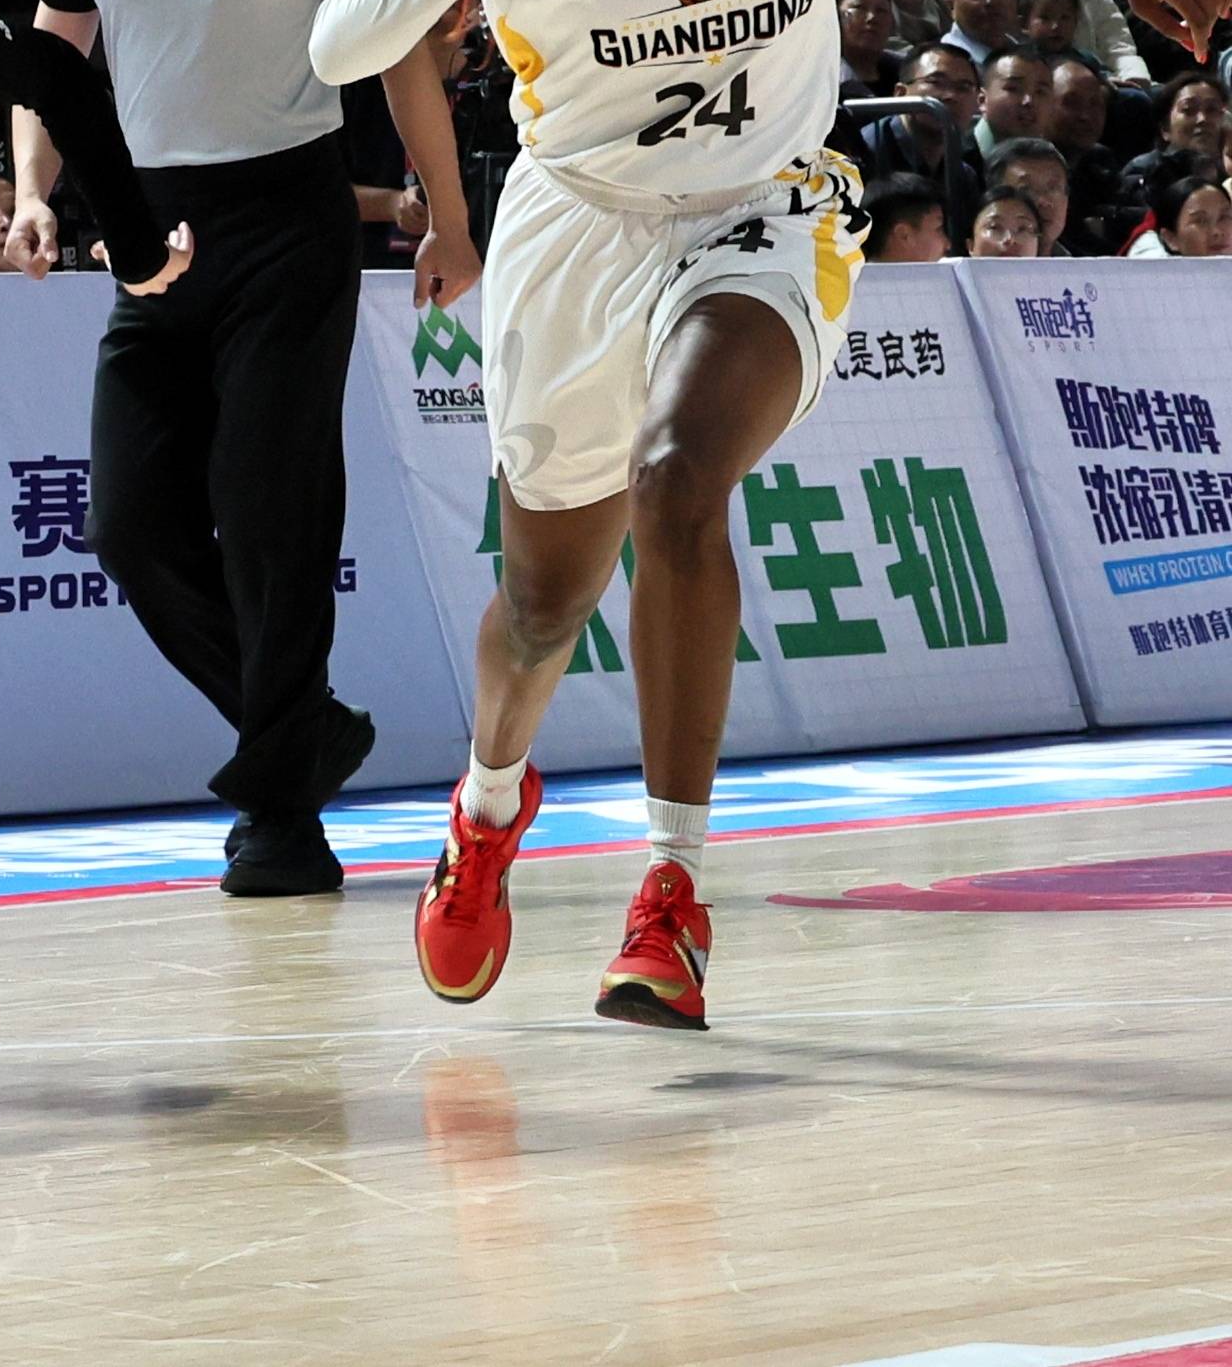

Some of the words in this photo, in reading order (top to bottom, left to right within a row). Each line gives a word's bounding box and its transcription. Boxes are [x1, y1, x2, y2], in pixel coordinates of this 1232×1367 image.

[636, 69, 756, 147] 24
[1056, 378, 1221, 455] 斯跑特牌
[1111, 563, 1158, 589] WHEY
[1157, 553, 1225, 583] PROTEIN
